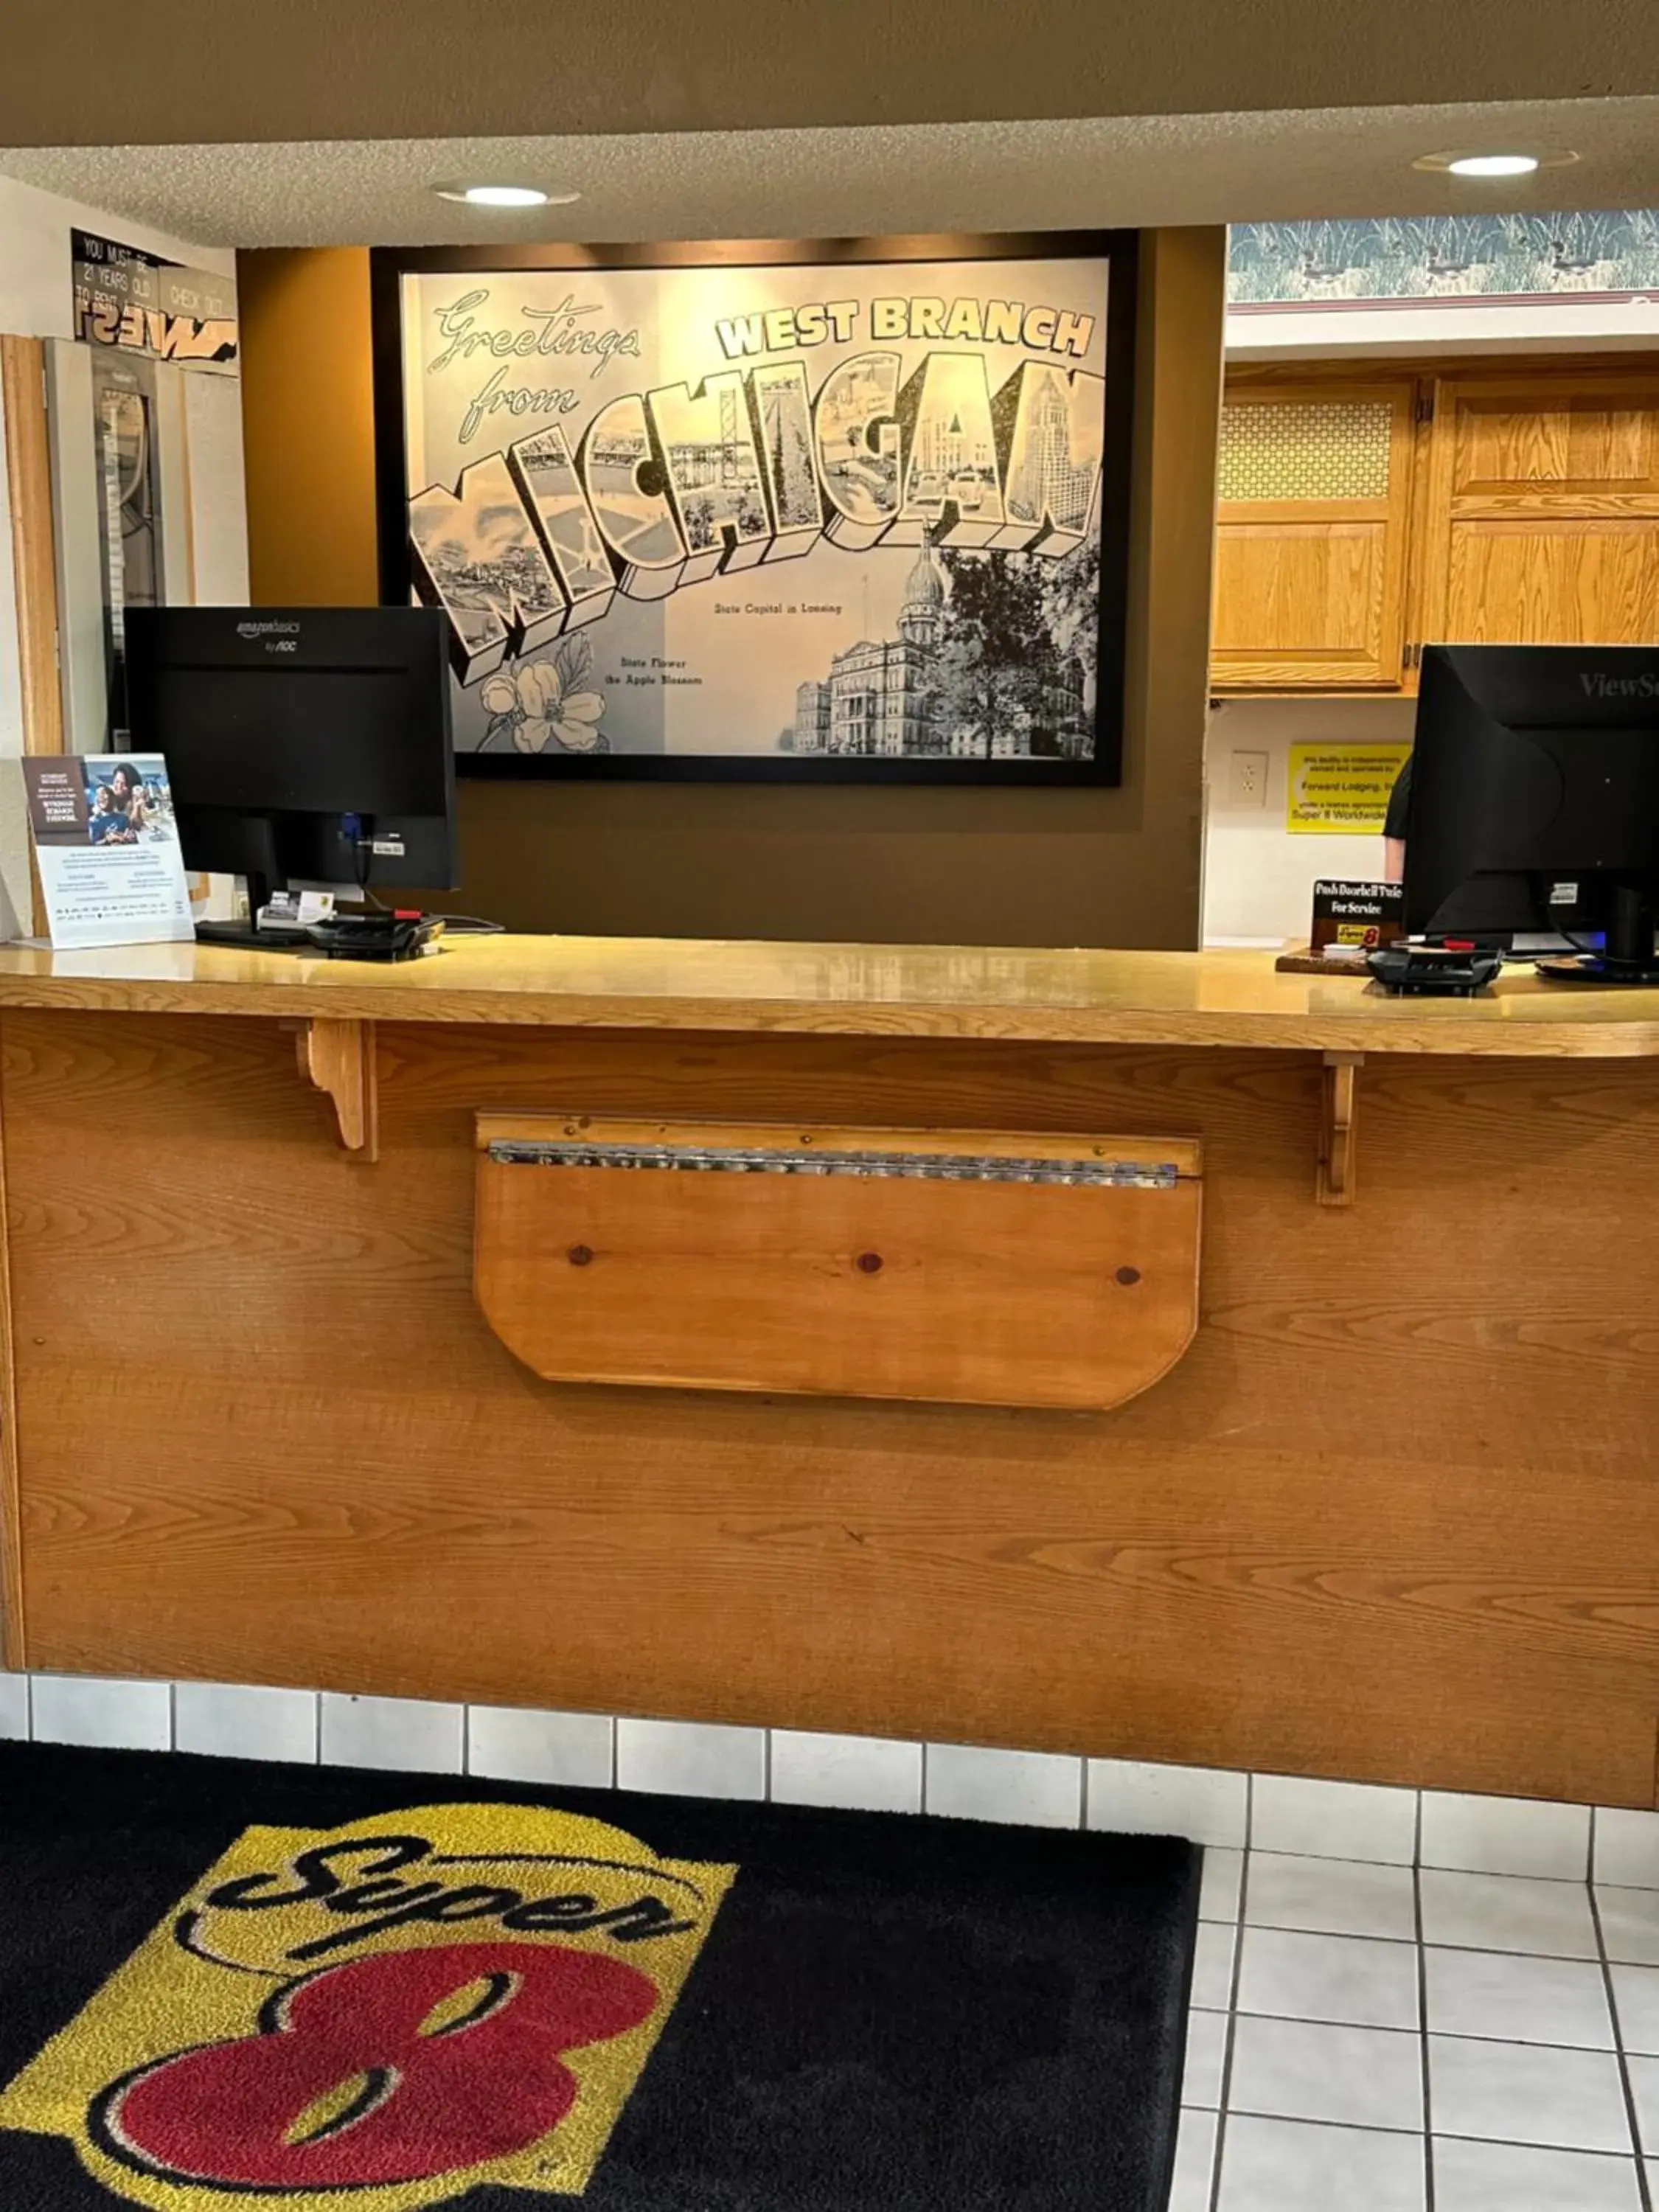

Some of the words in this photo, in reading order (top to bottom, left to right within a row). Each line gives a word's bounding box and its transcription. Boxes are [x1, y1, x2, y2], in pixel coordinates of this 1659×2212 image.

[83, 237, 104, 260] YOU
[100, 267, 128, 292] YEARS
[426, 288, 642, 380] Greetings
[715, 299, 860, 360] WEST
[871, 296, 1096, 358] BRANCH
[458, 364, 581, 445] from
[408, 351, 1106, 686] MICHIGAN
[714, 603, 740, 614] State
[787, 604, 796, 613] in
[801, 603, 842, 615] Lansing
[620, 656, 646, 667] State
[651, 656, 686, 668] Flower
[605, 674, 620, 685] the
[625, 674, 655, 686] Apple
[661, 674, 703, 685] Blossom
[1316, 883, 1338, 895] Push
[1339, 883, 1377, 897] Doorbell
[1332, 901, 1346, 913] For
[1348, 901, 1382, 914] Service
[1363, 928, 1377, 944] 8
[206, 1835, 698, 1961] Super
[86, 1941, 660, 2195] 8
